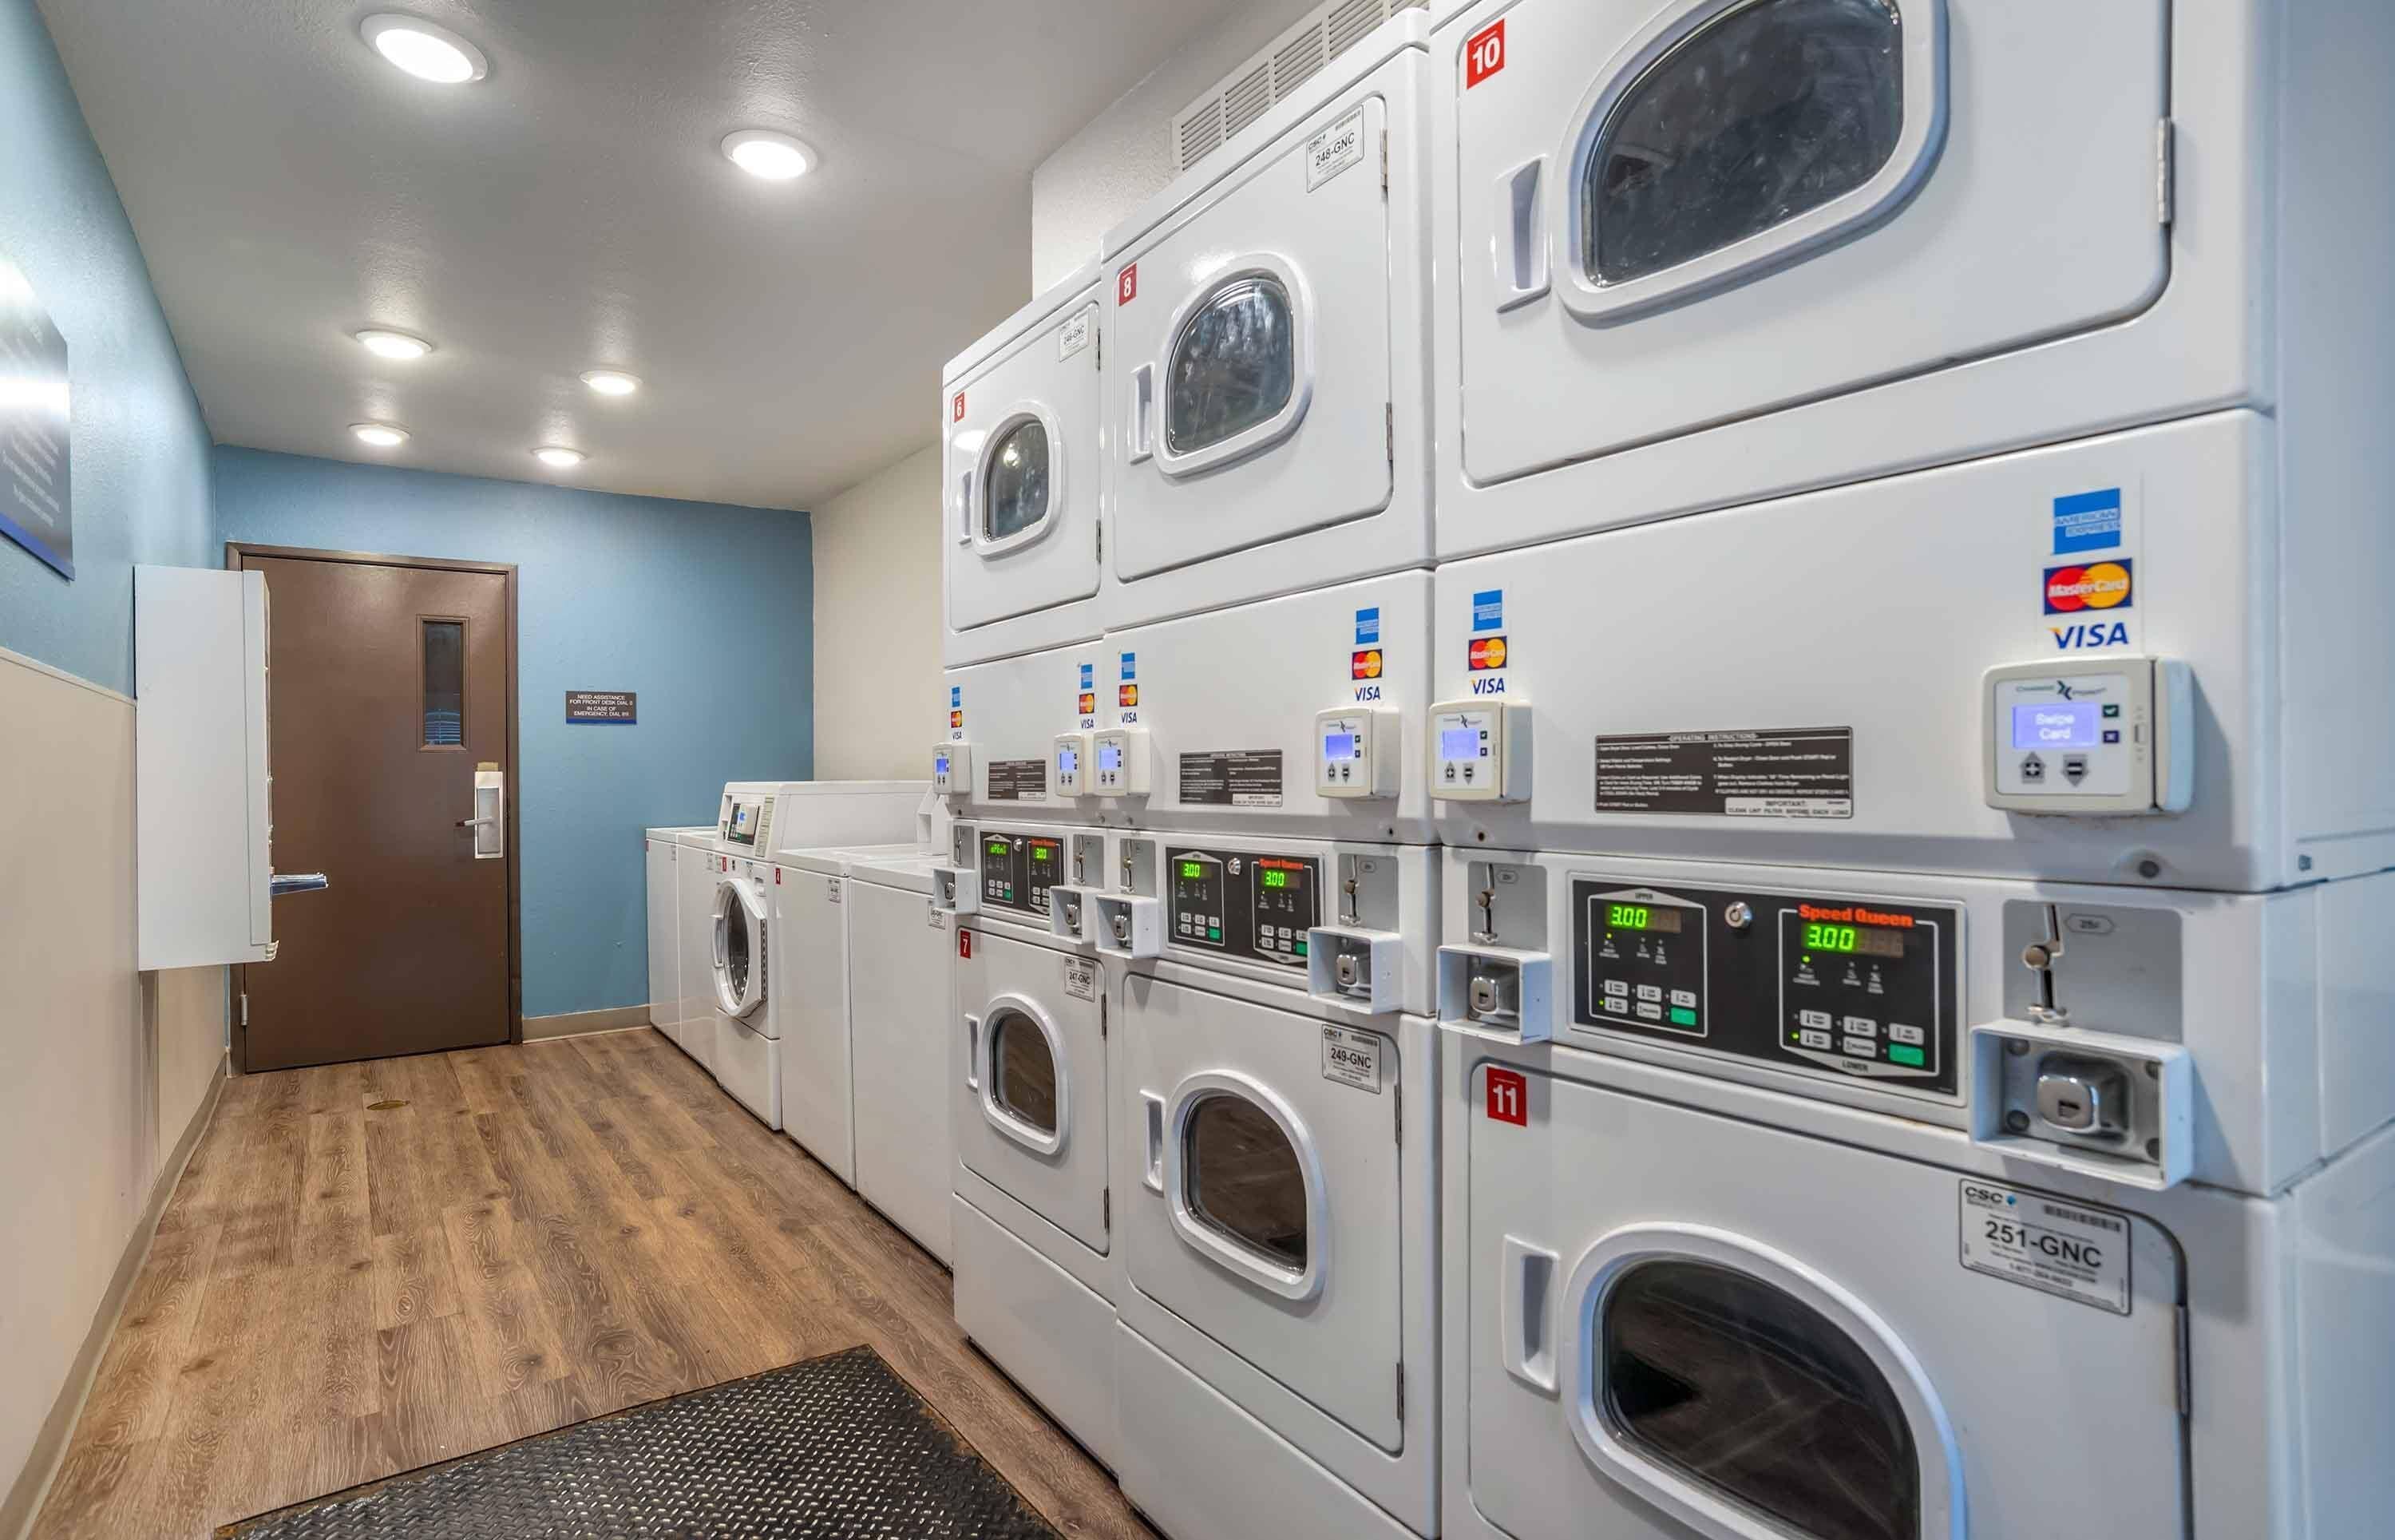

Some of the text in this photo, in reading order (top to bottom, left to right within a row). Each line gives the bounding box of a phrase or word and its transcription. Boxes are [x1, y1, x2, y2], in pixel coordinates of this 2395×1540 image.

[1472, 37, 1501, 75] 10
[1316, 133, 1355, 166] 248-GNC
[1124, 276, 1131, 297] 8
[2055, 509, 2119, 526] AMERICAN
[2049, 576, 2128, 598] MasterCard
[2048, 622, 2129, 650] VISA
[1355, 687, 1380, 701] VISA
[1471, 678, 1505, 695] VISA
[1080, 719, 1094, 729] VISA
[1121, 712, 1137, 723] VISA
[2035, 713, 2076, 728] Swipe
[2039, 727, 2072, 741] Card
[1610, 906, 1648, 928] 3.00
[1799, 904, 1914, 928] Speed Queen
[963, 938, 968, 954] 7
[1807, 925, 1855, 952] 3.00
[1331, 1047, 1372, 1068] 249-GNC
[1493, 1084, 1517, 1116] 11
[1965, 1186, 2004, 1204] CSC
[1985, 1220, 2102, 1268] 251-GNC
